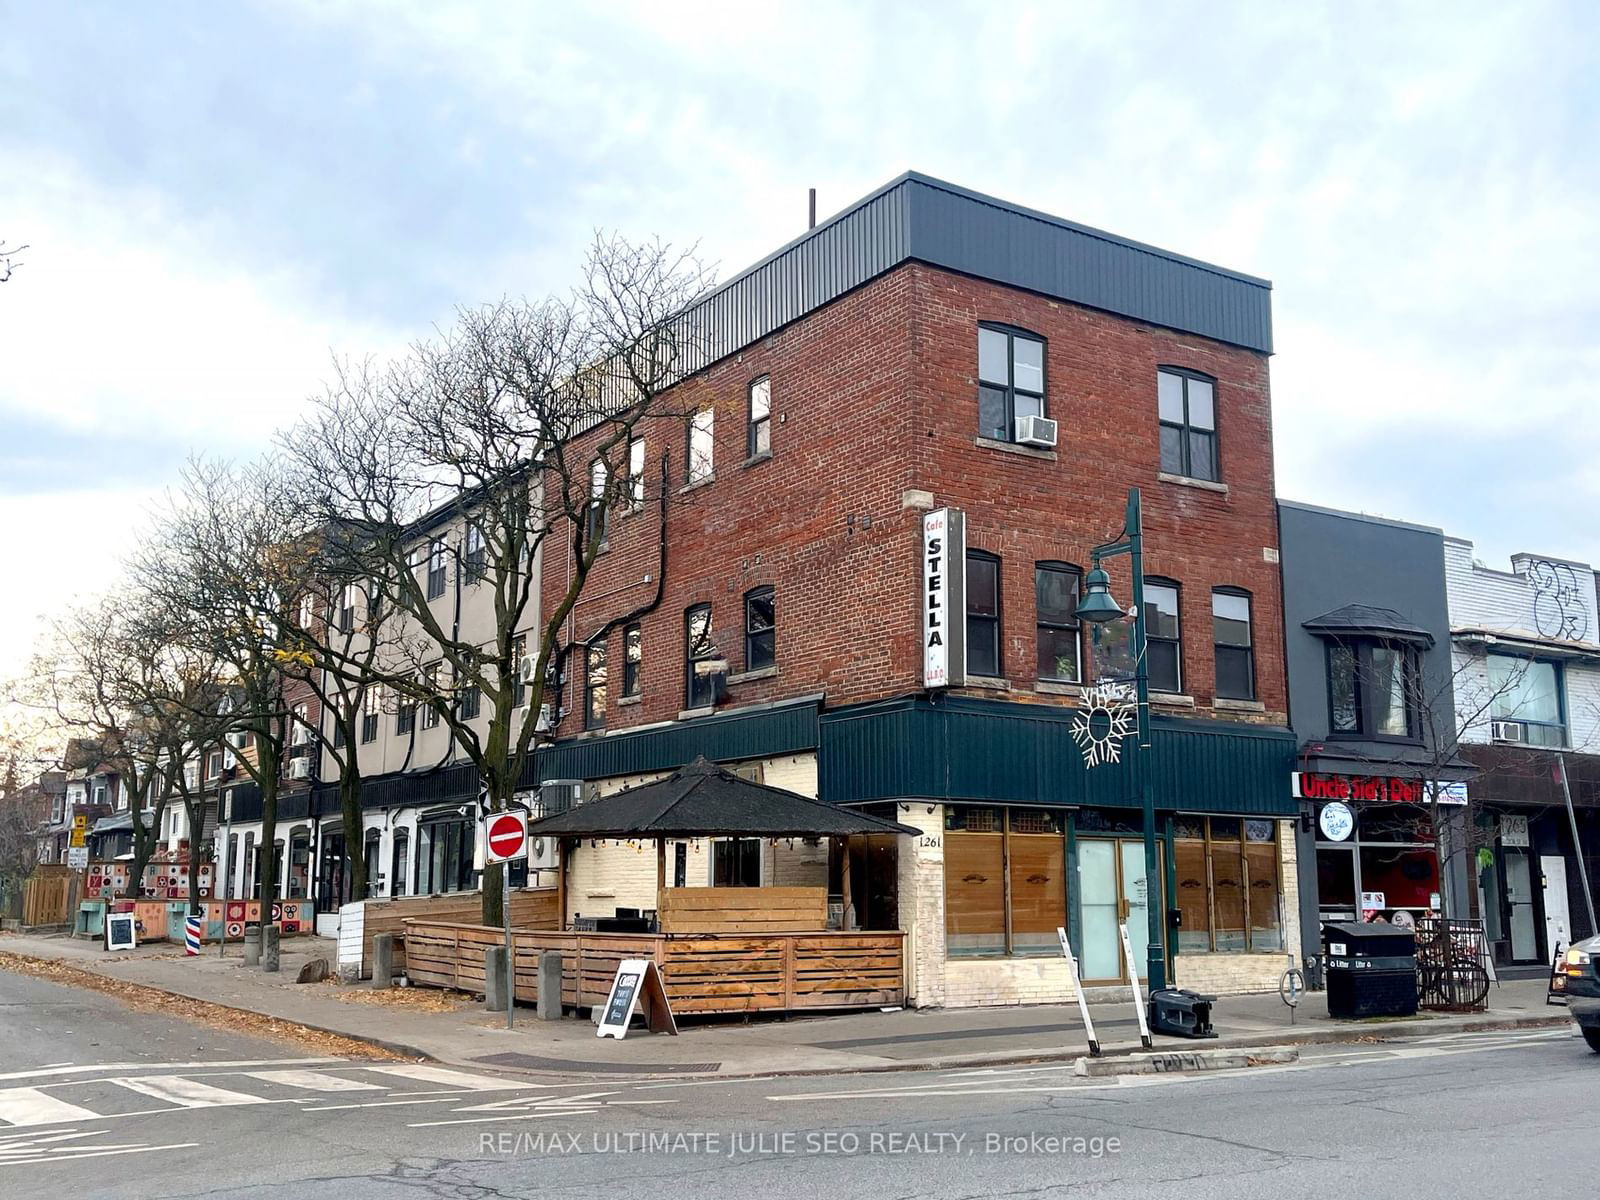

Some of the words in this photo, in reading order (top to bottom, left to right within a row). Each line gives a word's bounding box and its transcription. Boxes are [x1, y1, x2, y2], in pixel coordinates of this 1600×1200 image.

[928, 538, 943, 648] STELLA
[1302, 772, 1349, 799] Uncle
[1350, 776, 1388, 801] Sid's
[920, 836, 941, 848] 1261
